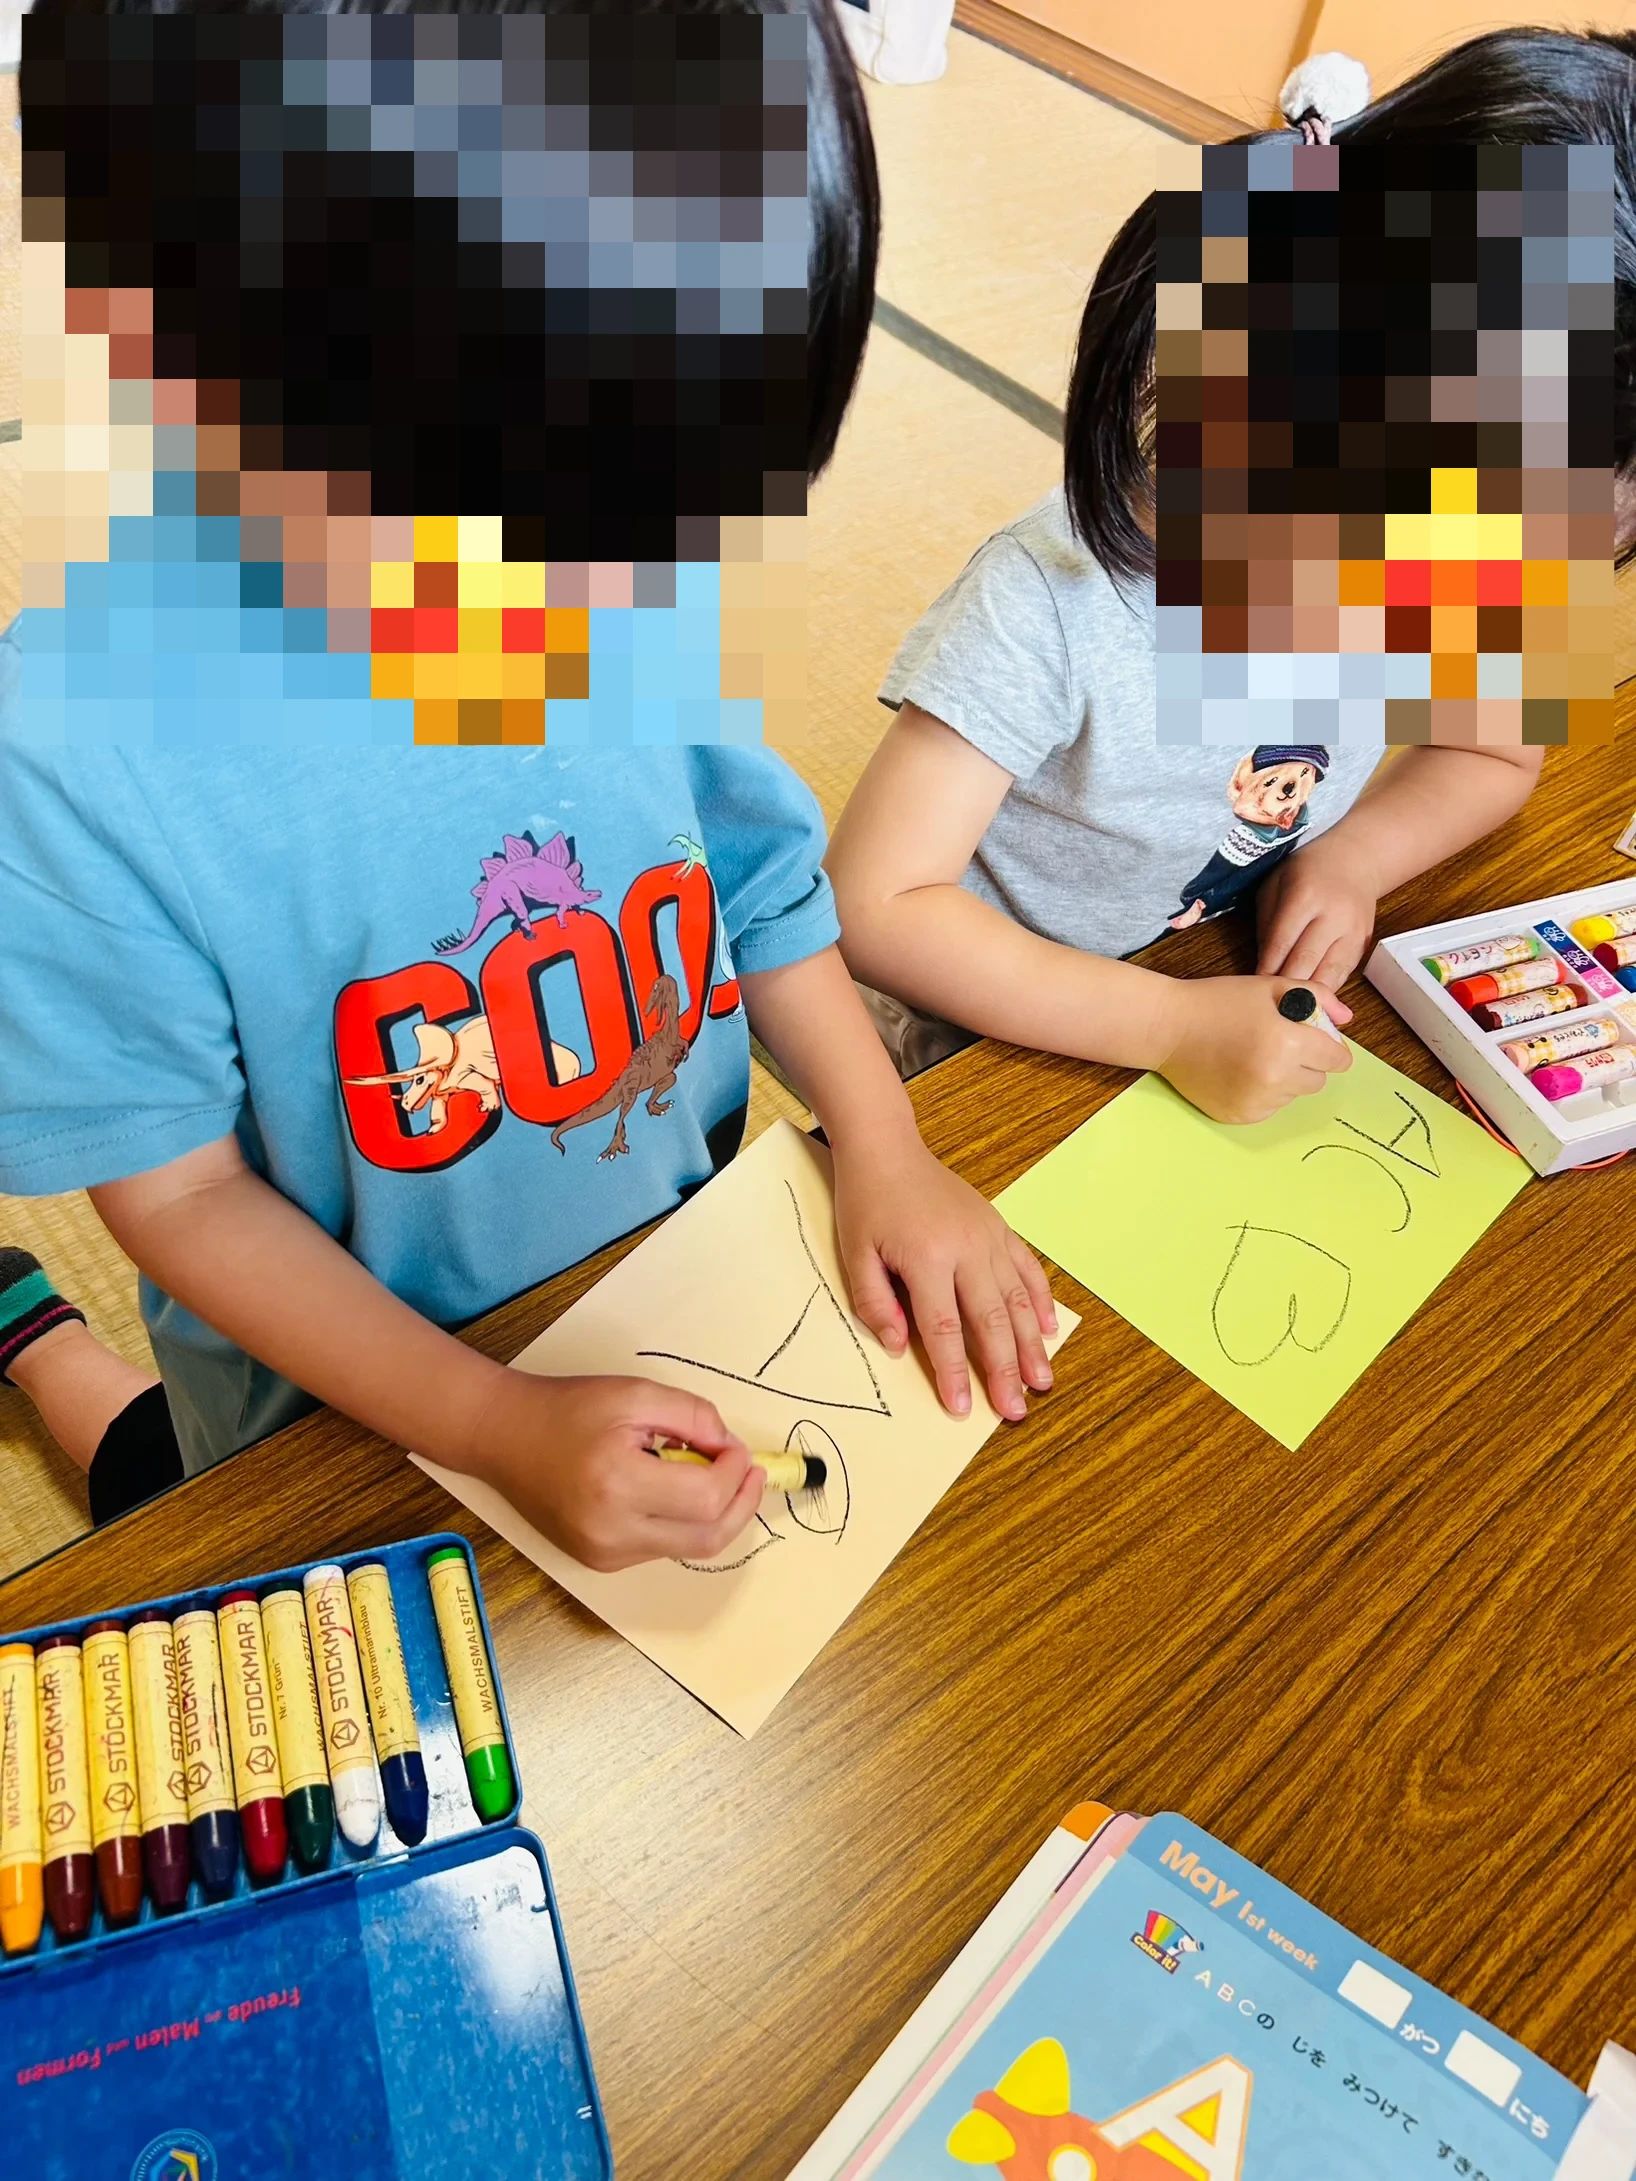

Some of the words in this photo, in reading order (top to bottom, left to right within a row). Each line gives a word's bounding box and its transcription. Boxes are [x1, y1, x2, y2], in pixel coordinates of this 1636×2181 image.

[334, 859, 742, 1173] COO
[176, 1635, 202, 1757] STOCKMAR
[237, 1621, 268, 1738] STOCKMAR
[316, 1597, 349, 1713] STOCKMAR
[360, 1605, 382, 1683] Ultramarinblau
[457, 1586, 494, 1713] WACHSMALSTIFT
[42, 1669, 67, 1795] STOCKMAR
[101, 1653, 128, 1773] STOCKMAR
[162, 1643, 185, 1762] STOCKMAR
[1158, 1839, 1240, 1909] May
[1267, 1928, 1319, 1970] week
[134, 2017, 201, 2050] Malen
[227, 1985, 301, 2023] Freude
[1399, 2022, 1441, 2056] がつ
[16, 2047, 101, 2087] Formen
[1342, 2072, 1419, 2135] みつけて
[1508, 2098, 1550, 2140] にち
